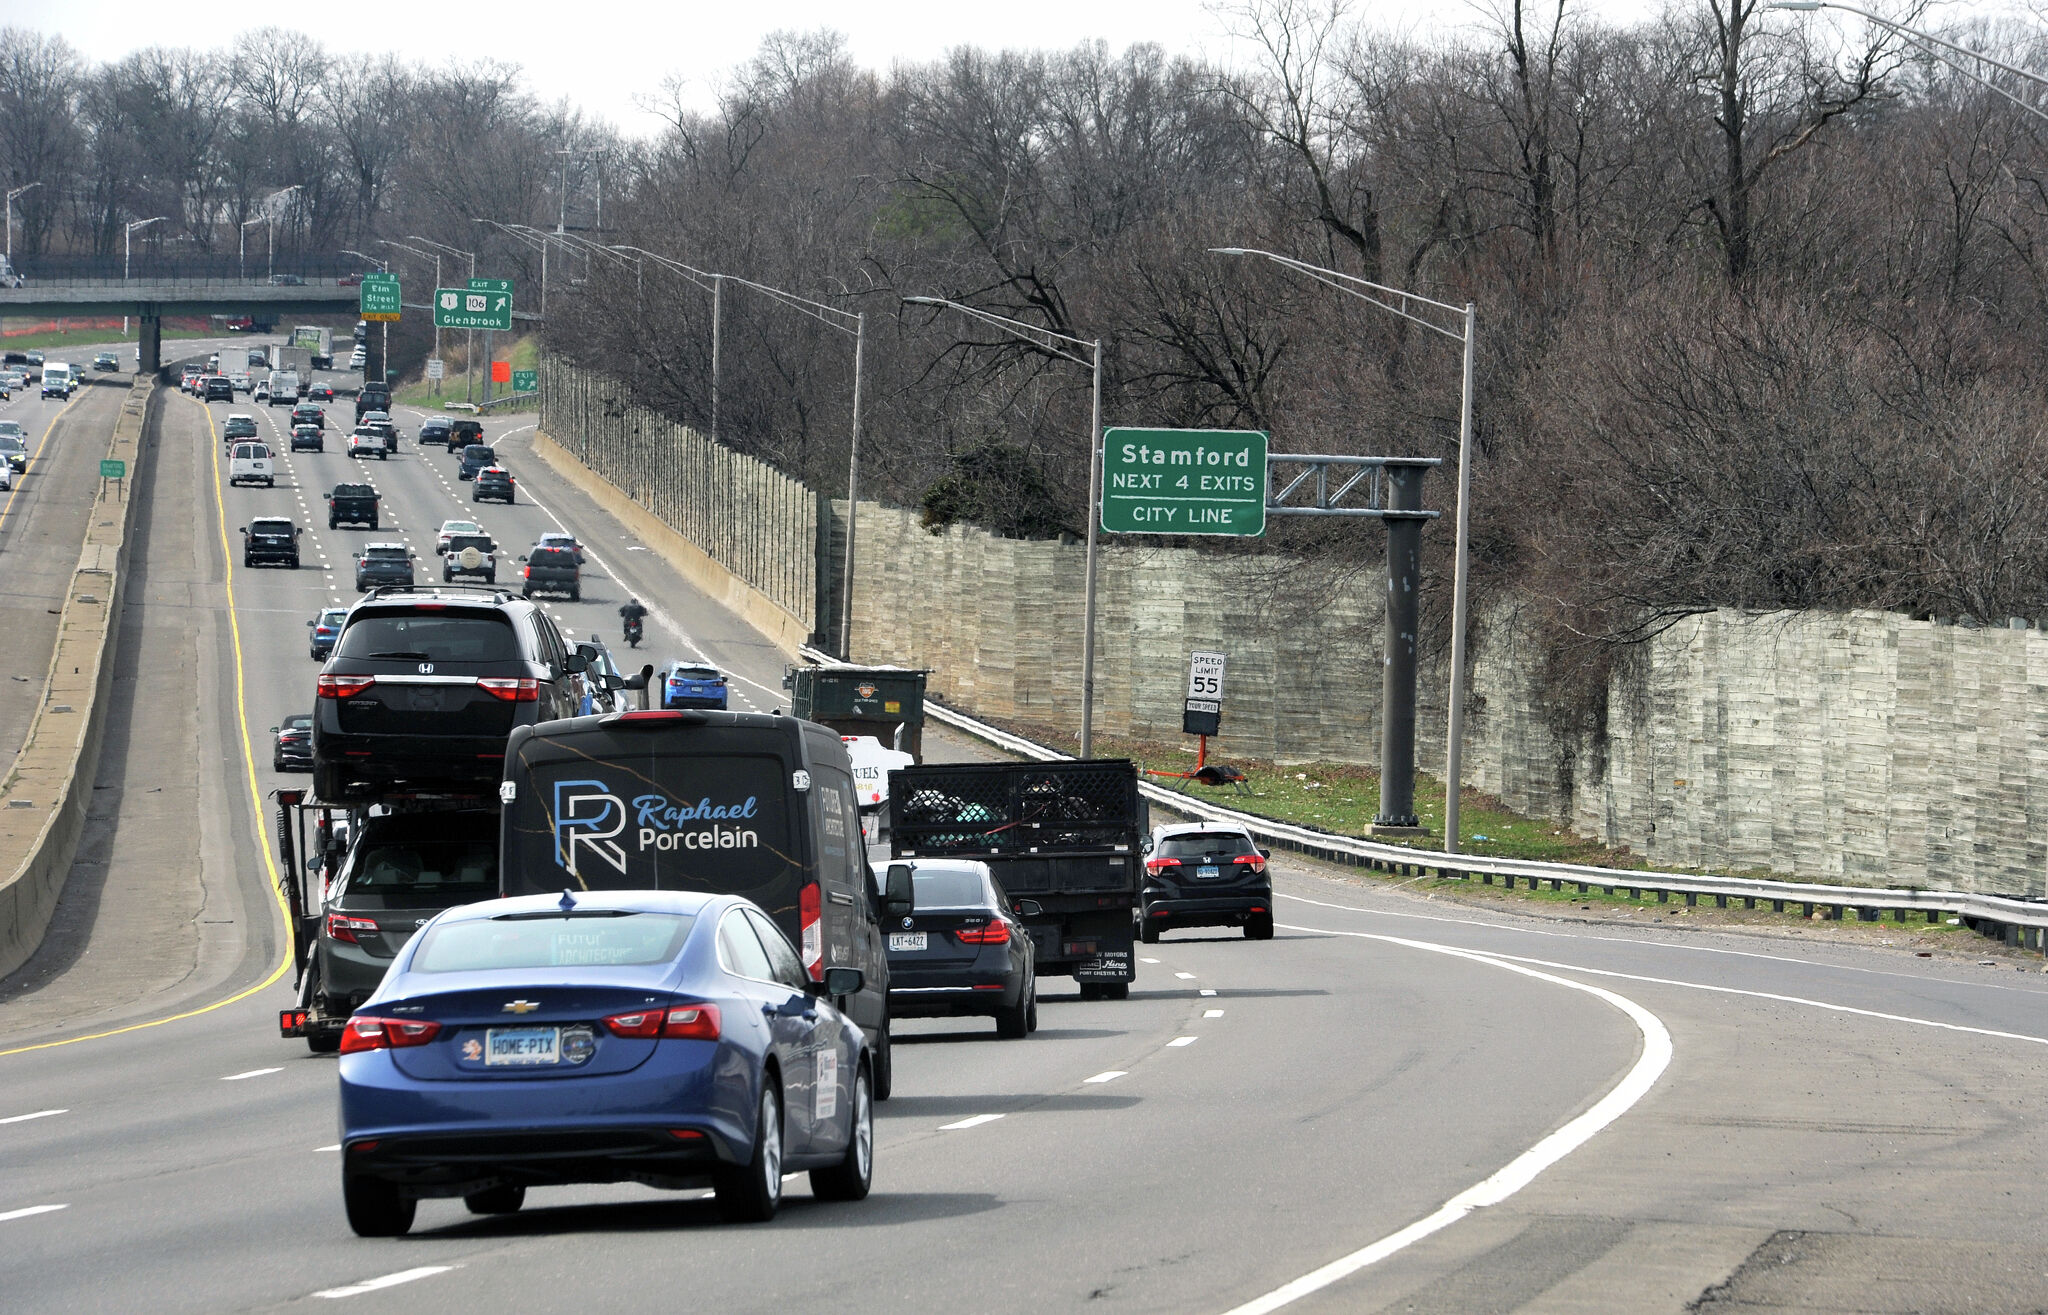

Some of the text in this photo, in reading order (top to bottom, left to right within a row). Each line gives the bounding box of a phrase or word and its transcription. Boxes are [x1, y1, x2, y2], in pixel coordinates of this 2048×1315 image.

[501, 281, 508, 290] 9
[367, 294, 394, 303] Street
[468, 298, 485, 309] 106
[379, 313, 399, 321] ONLY
[444, 315, 501, 326] Glenbrook
[519, 379, 525, 387] 9
[1122, 444, 1249, 467] Stamford
[1112, 472, 1255, 492] NEXT 4 EXITS
[1132, 506, 1233, 525] CITY LINE
[1194, 657, 1222, 665] SPEED
[1196, 667, 1219, 675] LIMIT
[1194, 677, 1218, 693] 55
[1188, 702, 1216, 711] YOUR SPEED
[632, 794, 758, 831] Raphael
[639, 823, 758, 852] Porcelain
[493, 1038, 553, 1055] HOME-PIX
